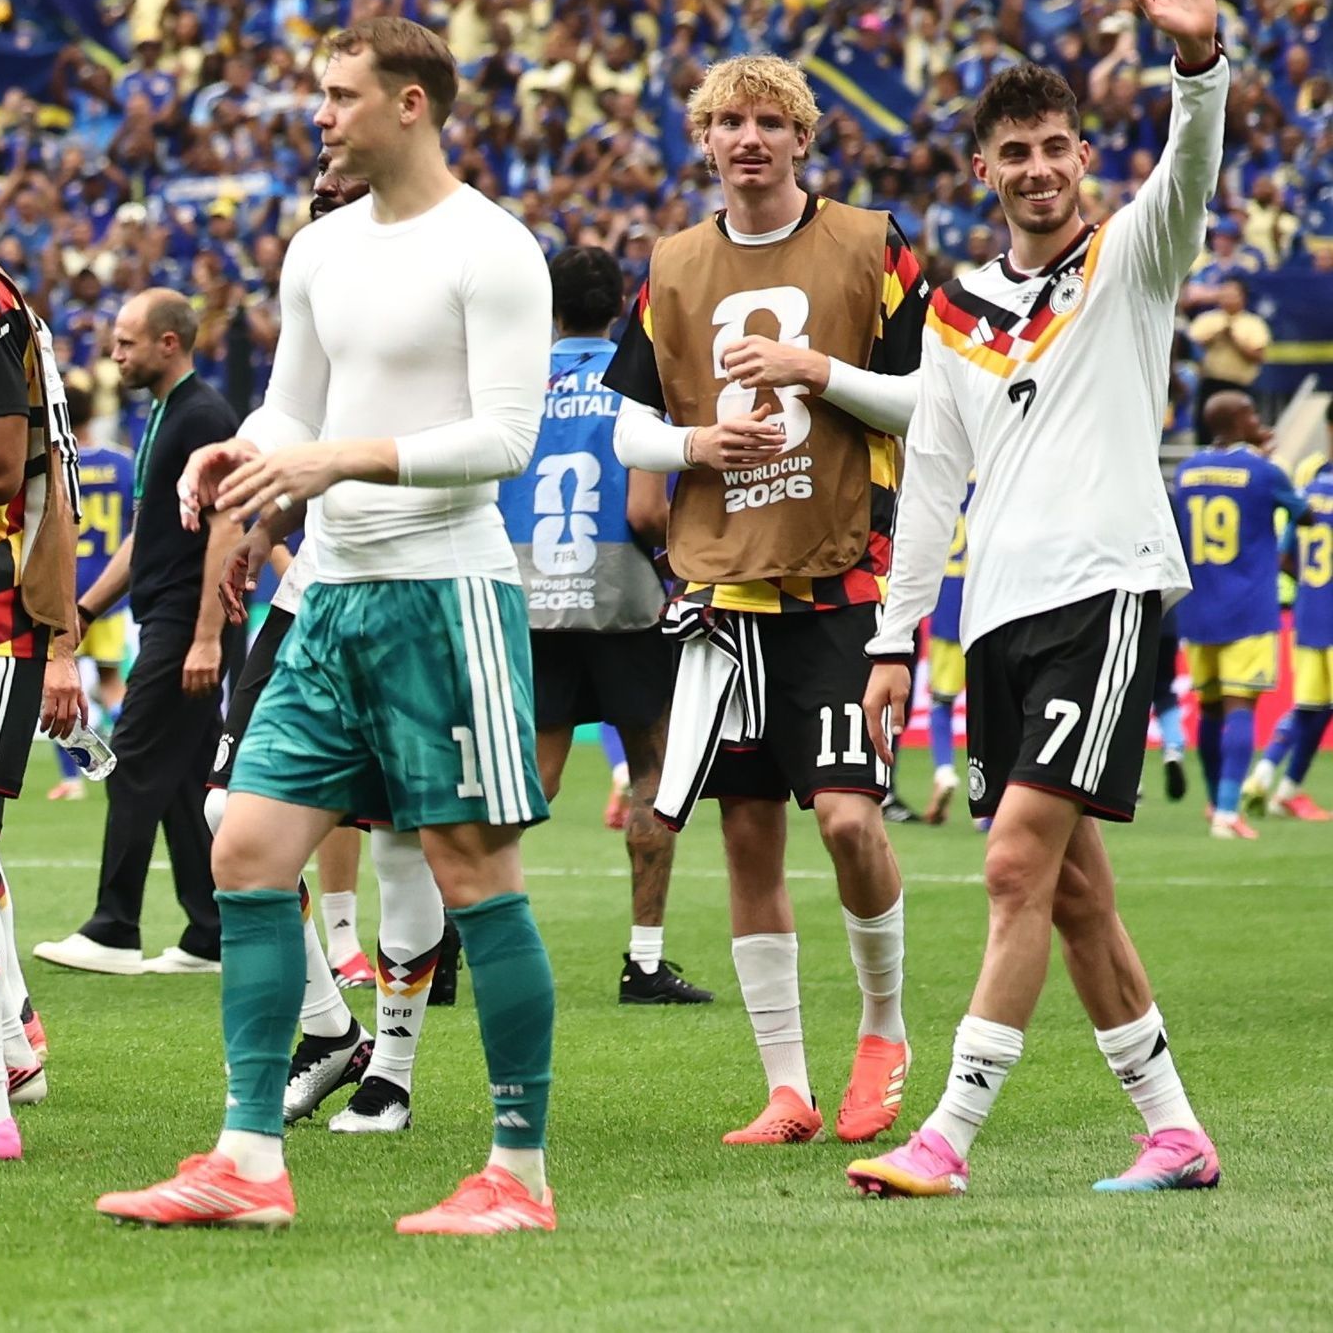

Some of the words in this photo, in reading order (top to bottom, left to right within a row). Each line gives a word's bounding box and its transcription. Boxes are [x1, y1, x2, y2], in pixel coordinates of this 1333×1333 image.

[546, 394, 618, 419] IGITAL
[1007, 378, 1035, 422] 7
[722, 462, 780, 486] WORLD
[780, 455, 813, 474] CUP
[724, 474, 813, 514] 2026
[1187, 495, 1241, 565] 19
[1296, 522, 1333, 588] 13
[528, 591, 596, 610] 2026
[530, 578, 571, 591] WORLD
[572, 577, 597, 590] CUP
[817, 703, 867, 767] 11
[1035, 698, 1081, 765] 7
[452, 726, 484, 799] 1
[382, 1006, 413, 1018] DFB
